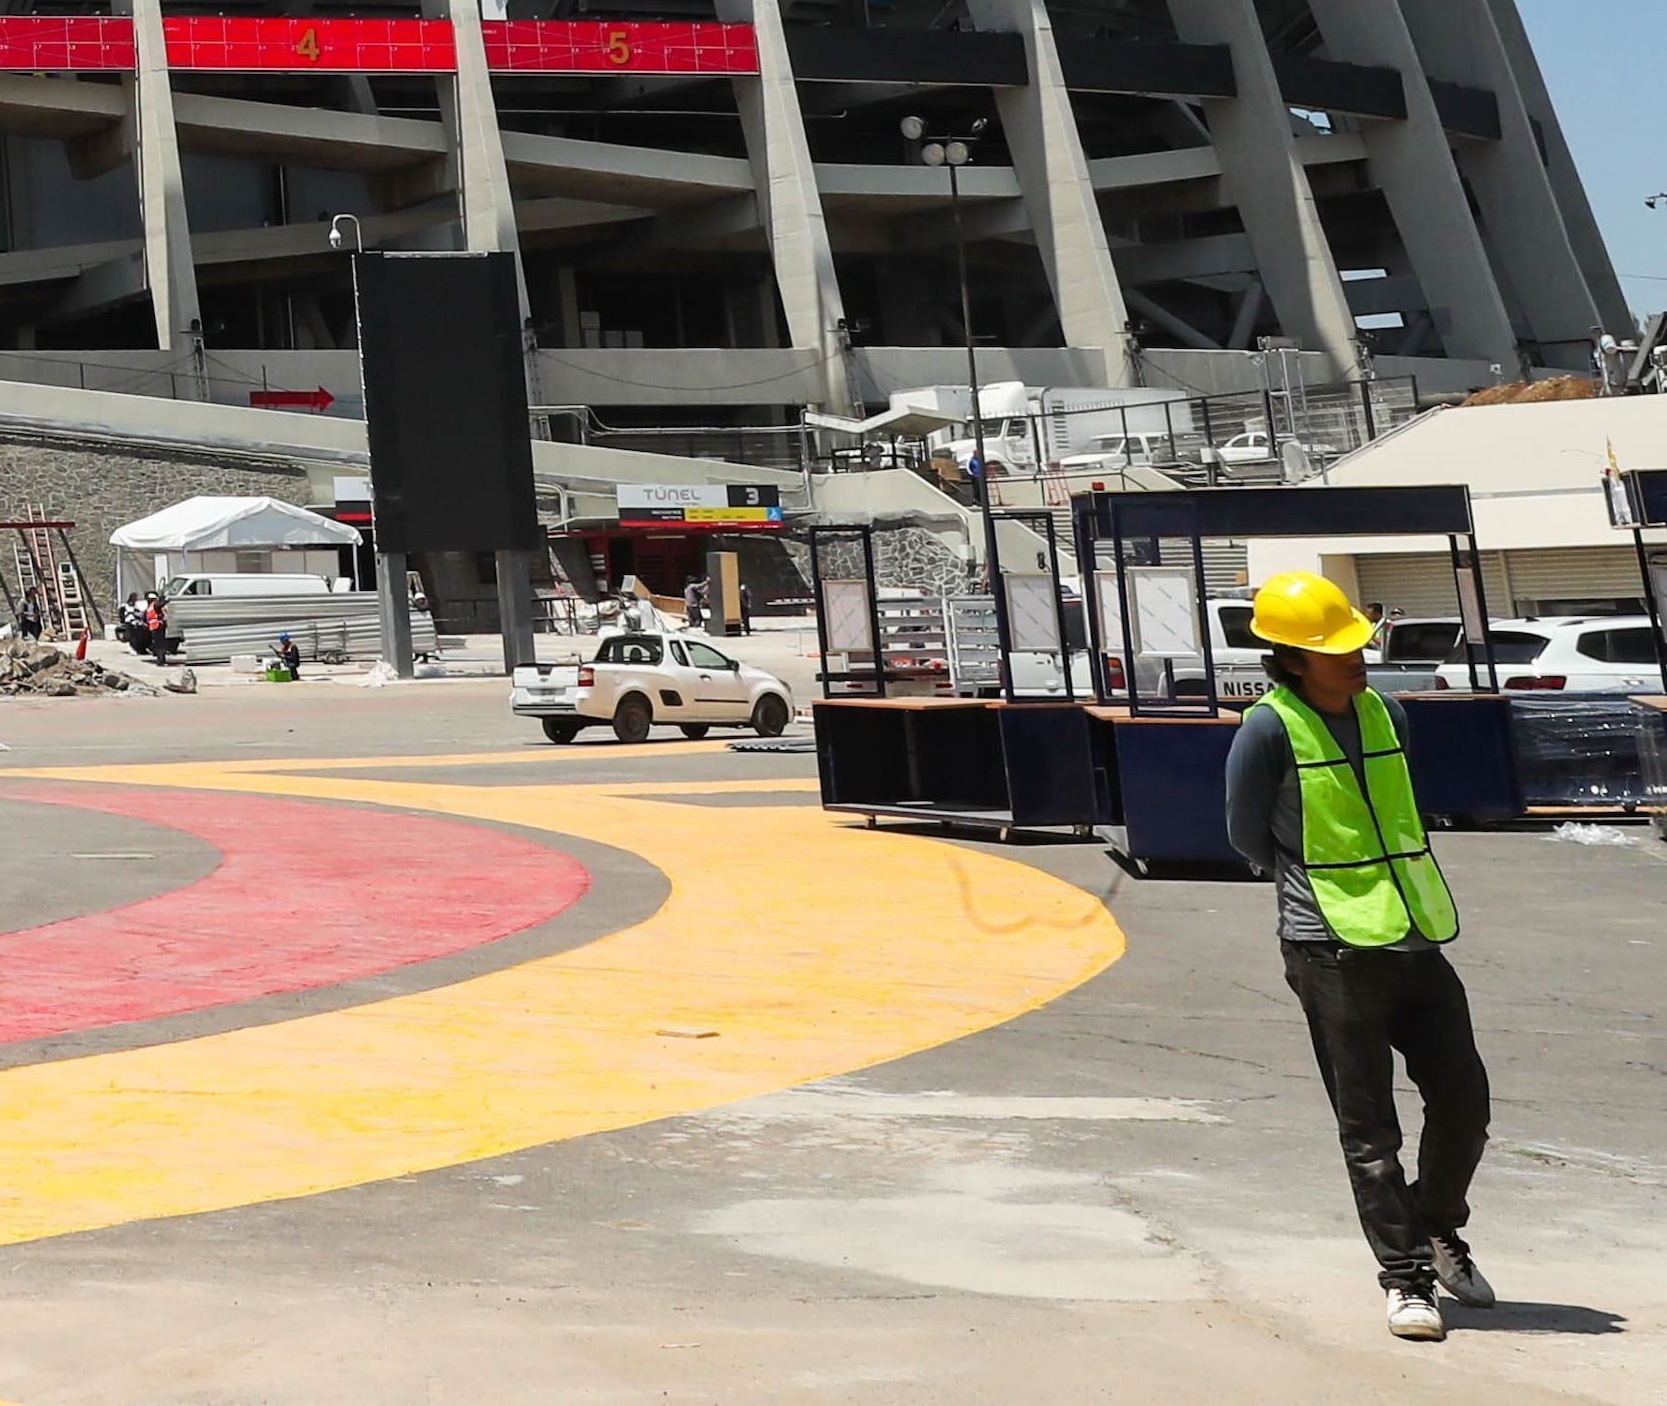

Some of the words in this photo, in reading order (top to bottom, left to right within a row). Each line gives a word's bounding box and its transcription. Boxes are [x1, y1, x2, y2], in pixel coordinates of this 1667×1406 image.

[297, 28, 320, 62] 4
[609, 32, 630, 64] 5
[643, 486, 701, 501] TÚNEL
[745, 487, 759, 505] 3
